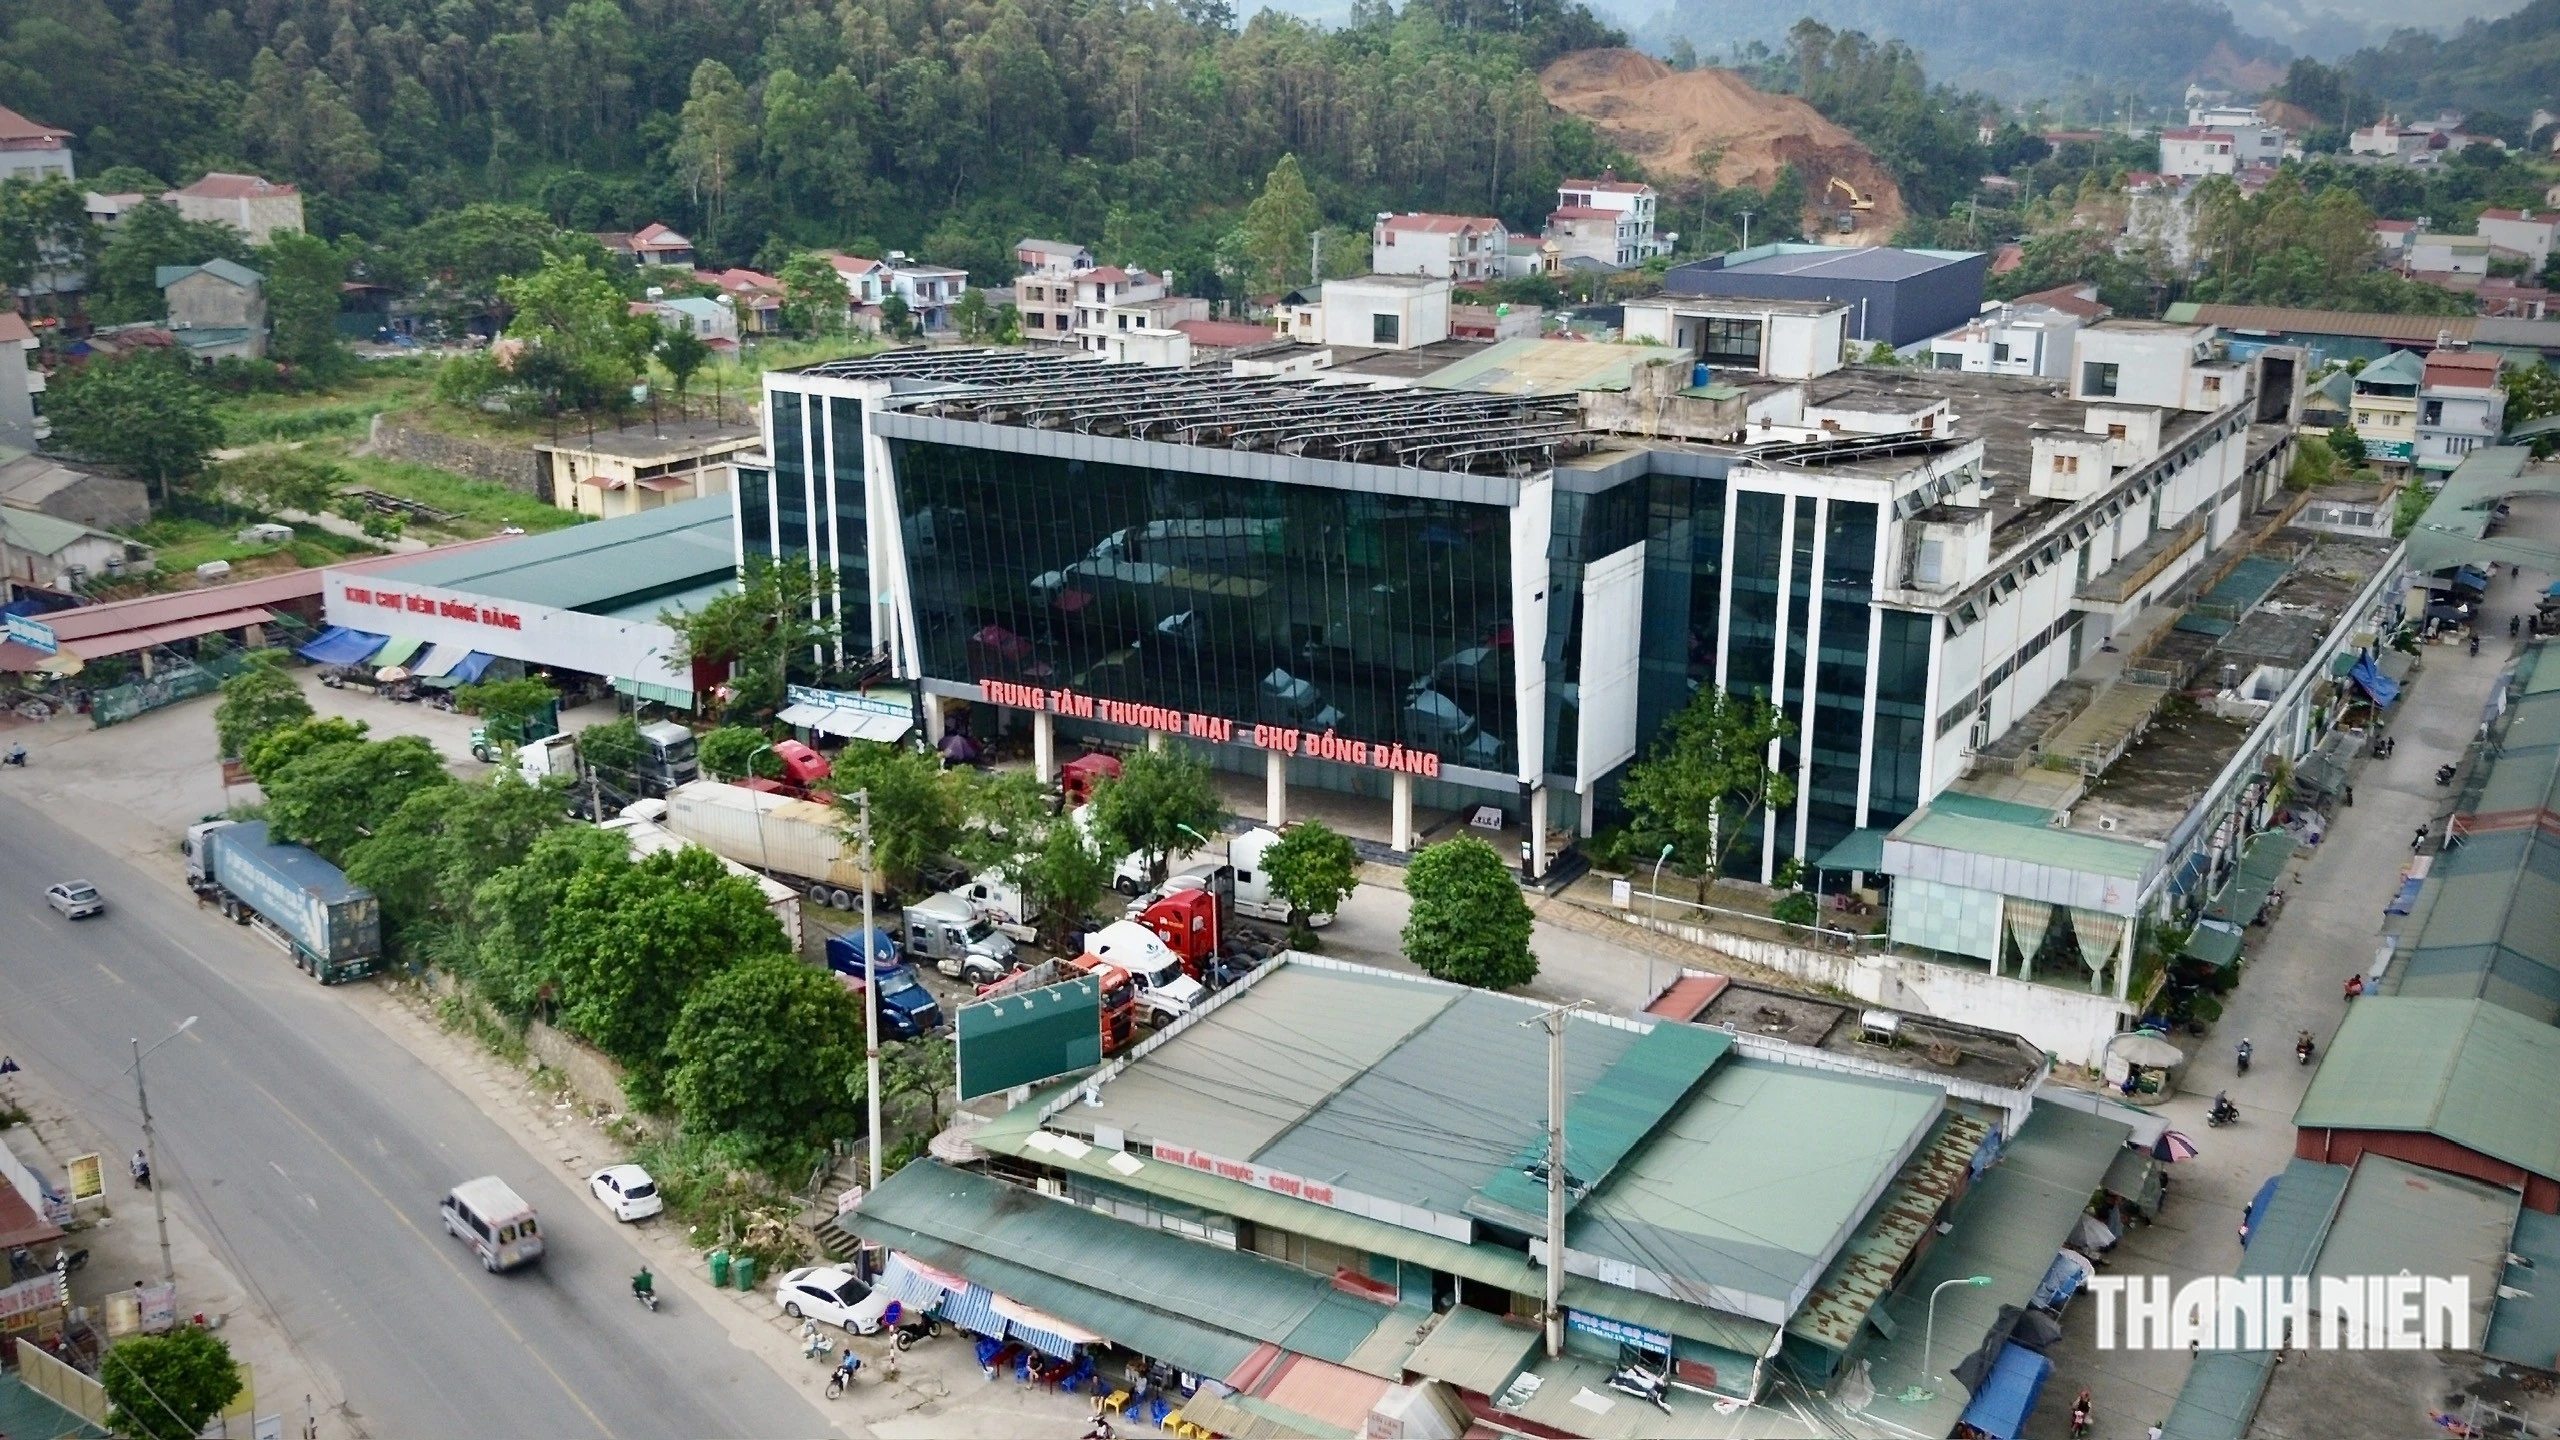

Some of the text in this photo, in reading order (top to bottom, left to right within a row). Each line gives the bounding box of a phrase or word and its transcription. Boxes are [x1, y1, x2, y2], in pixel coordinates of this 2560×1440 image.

[345, 587, 371, 604] KHU
[376, 591, 402, 612] CHỢ
[979, 679, 1045, 711] TRUNG
[1050, 688, 1093, 718] TÂM
[1098, 699, 1182, 733] THƯƠNG
[1188, 713, 1233, 744] MẠI
[1254, 724, 1299, 757] CHỢ
[1304, 727, 1367, 765] ĐỒNG
[1373, 742, 1438, 778] ĐĂNG
[1155, 1145, 1185, 1164] KHU
[1268, 1174, 1301, 1196] CHỢ
